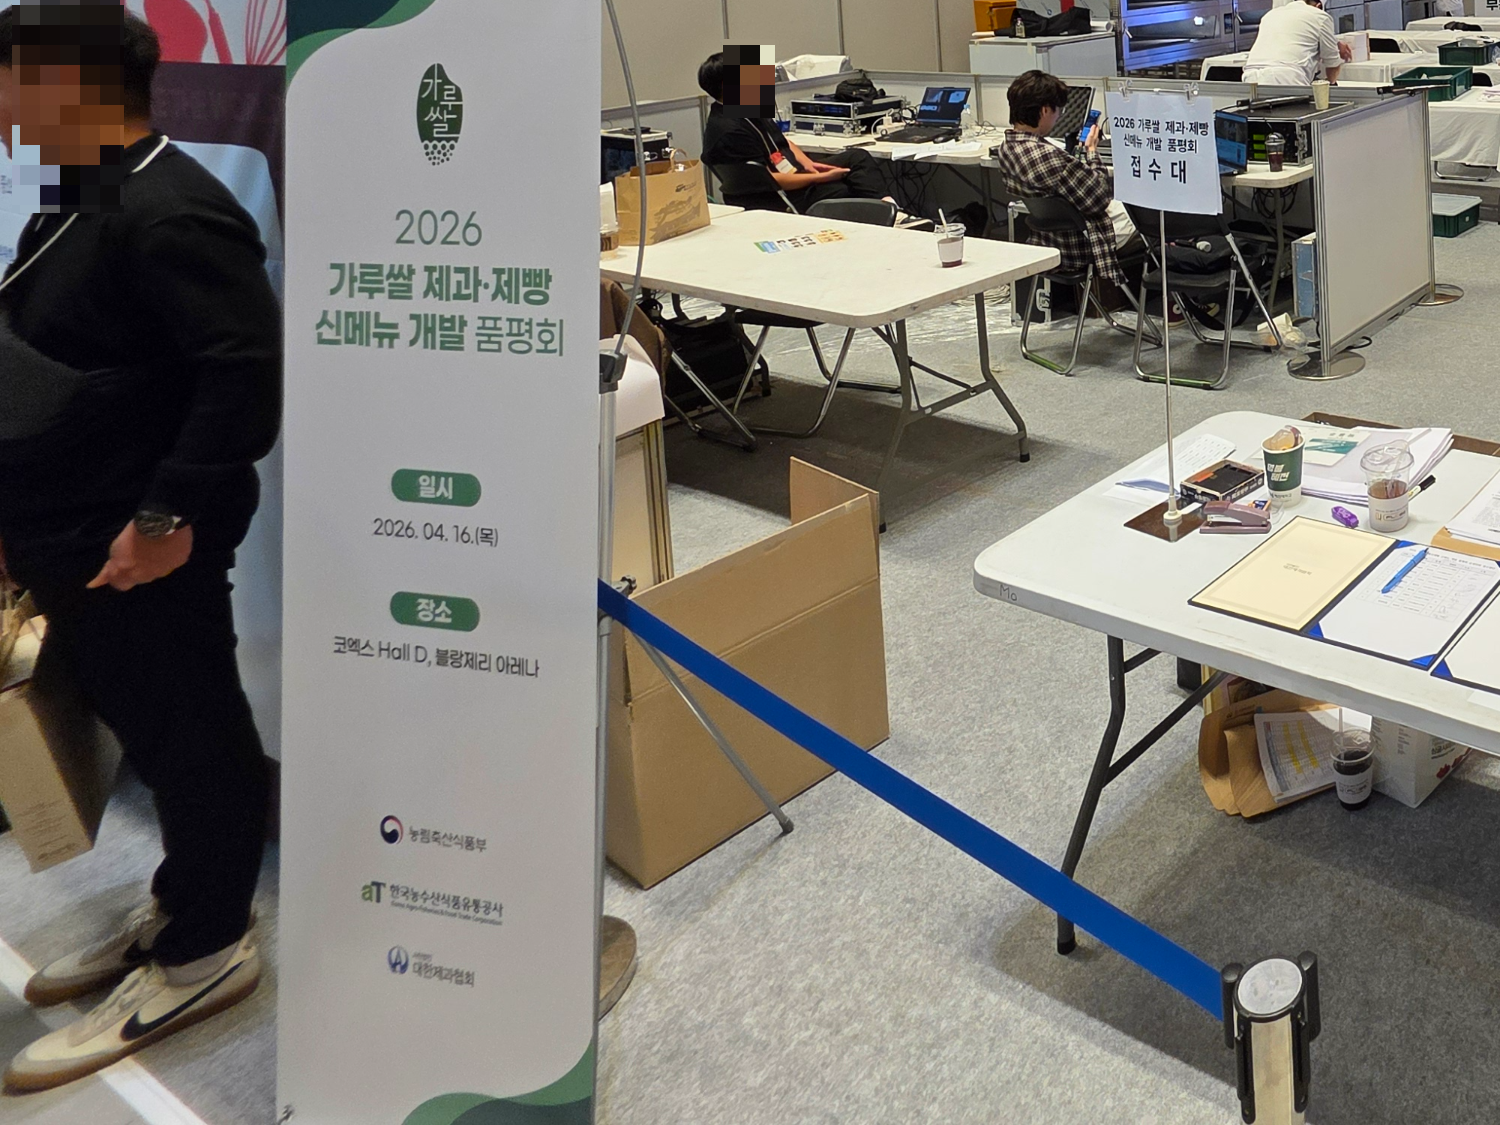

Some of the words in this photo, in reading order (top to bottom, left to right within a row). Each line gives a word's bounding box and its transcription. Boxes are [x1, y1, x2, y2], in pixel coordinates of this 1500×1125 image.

[1113, 116, 1135, 129] 2026
[1137, 118, 1160, 134] 가루쌀
[1123, 134, 1143, 149] 신메뉴
[1146, 137, 1163, 152] 개발
[1167, 138, 1198, 154] 품평회
[395, 209, 483, 247] 2026
[329, 262, 416, 301] 가루쌀
[423, 265, 553, 306] 제과·제빵
[315, 309, 401, 349] 신메뉴
[408, 313, 468, 352] 개발
[475, 315, 565, 357] 품평회
[419, 475, 453, 499] 일시
[373, 517, 419, 539] 2026.
[423, 522, 448, 542] 04.
[452, 525, 499, 547] 16.(목)
[416, 598, 452, 623] 장소
[333, 635, 375, 658] 코엑스
[378, 641, 411, 661] Hall
[415, 646, 432, 667] D,
[435, 647, 492, 673] 블랑제리
[496, 655, 540, 678] 아레나
[409, 826, 487, 853] 농림축산식품부
[389, 883, 504, 917] 한국농수산식품유통공사
